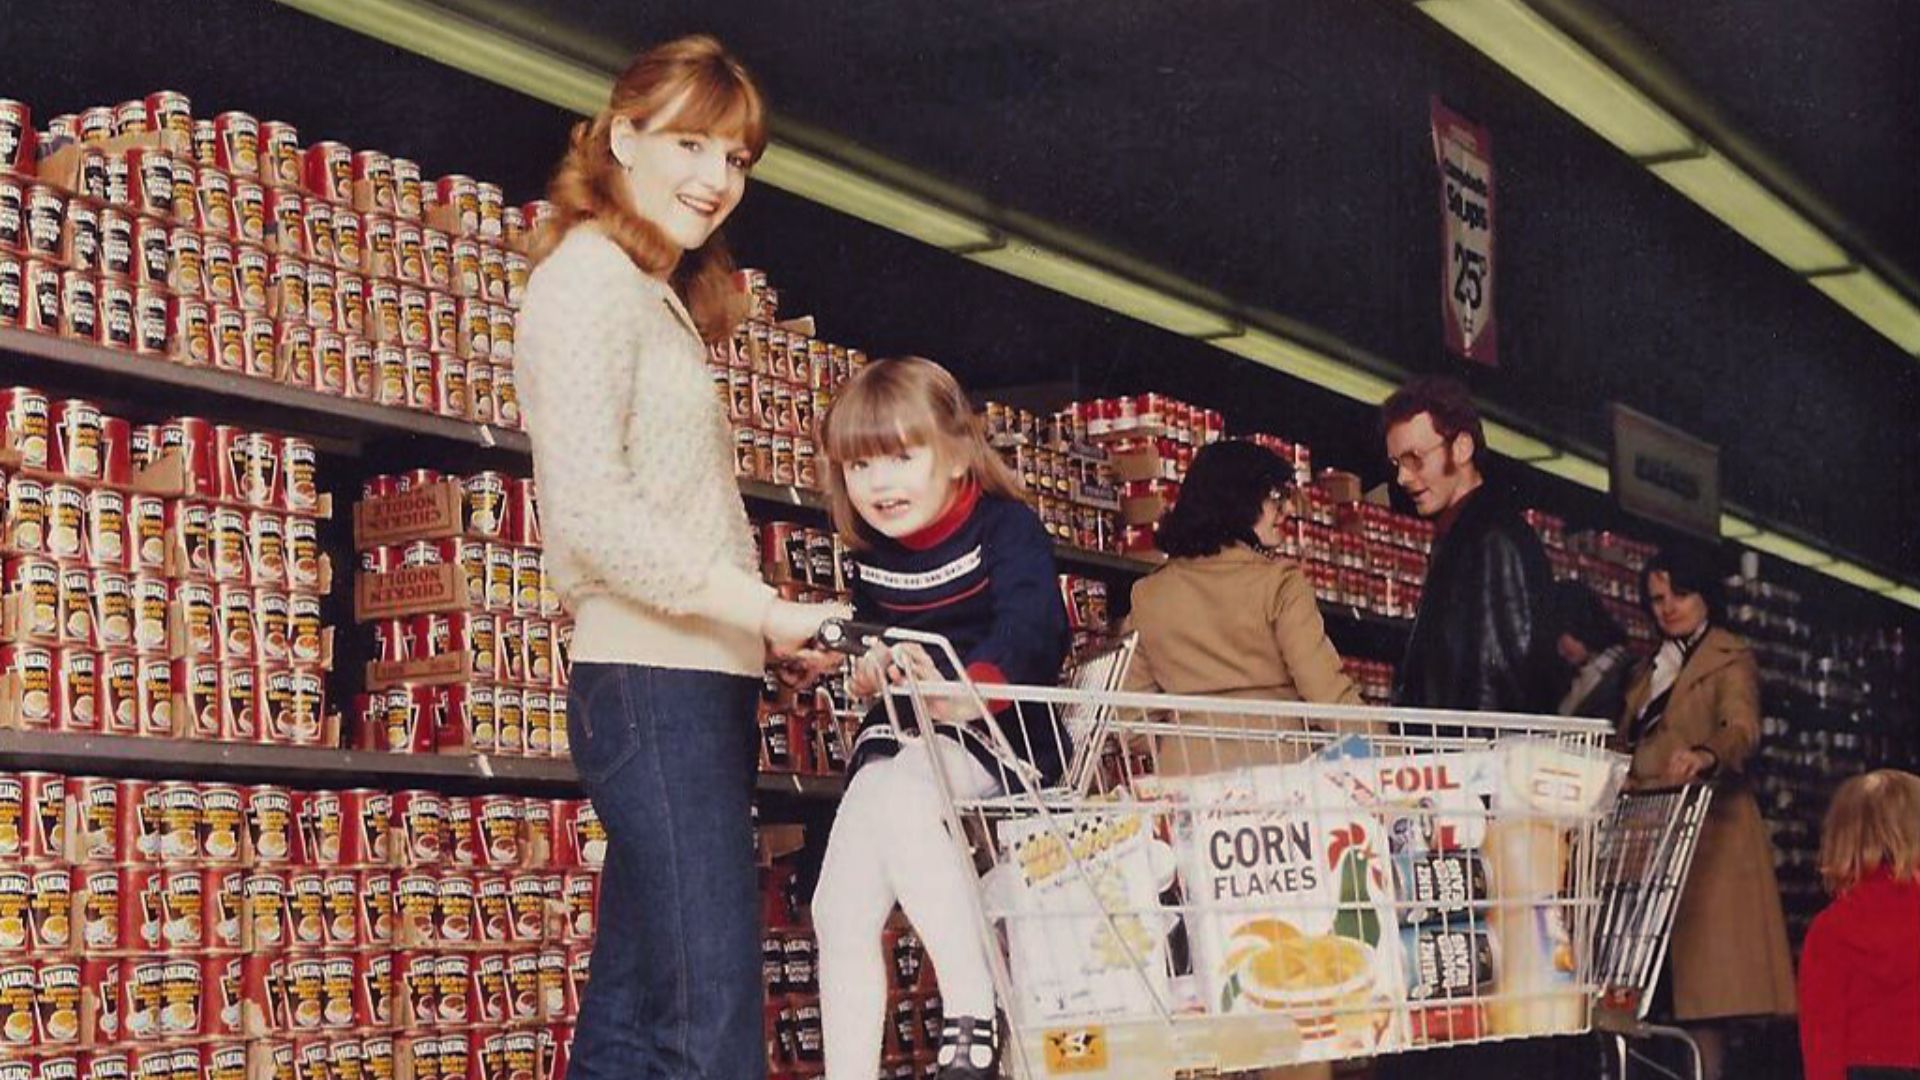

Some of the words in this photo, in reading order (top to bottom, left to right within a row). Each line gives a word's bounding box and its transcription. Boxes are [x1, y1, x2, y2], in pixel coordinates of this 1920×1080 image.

[1379, 766, 1460, 793] FOIL
[1210, 821, 1312, 871] CORN
[1214, 866, 1317, 900] FLAKES
